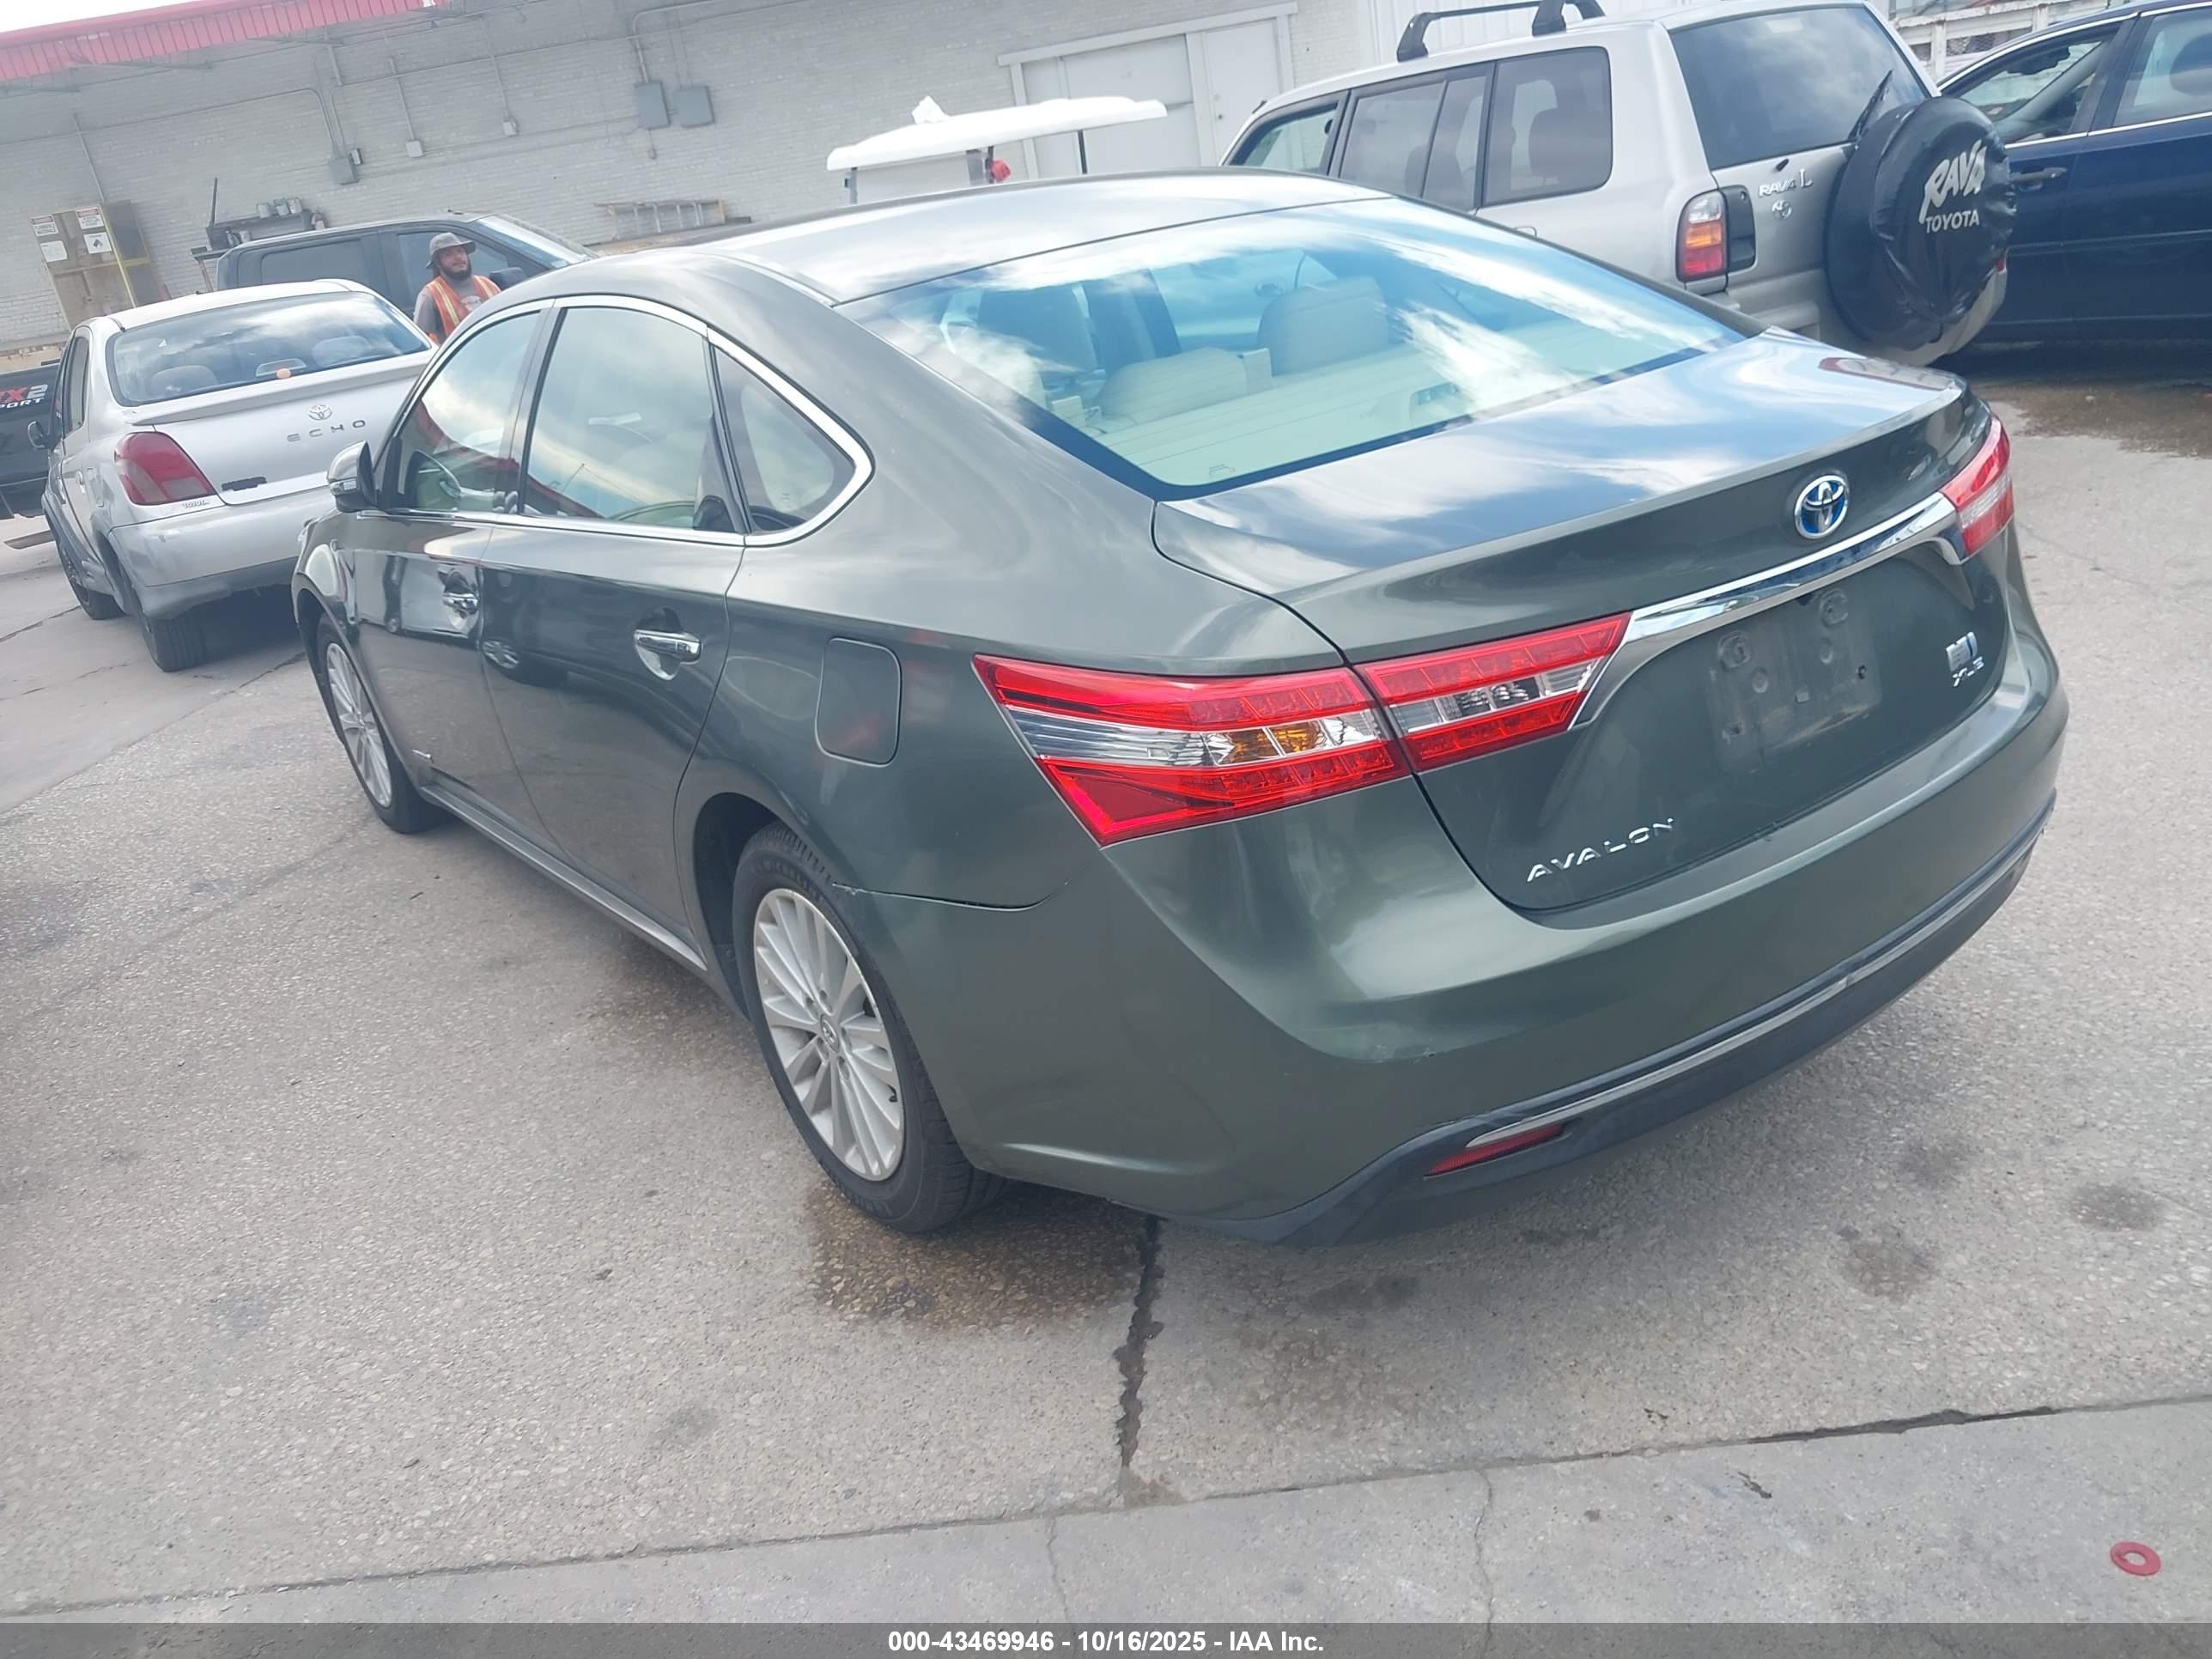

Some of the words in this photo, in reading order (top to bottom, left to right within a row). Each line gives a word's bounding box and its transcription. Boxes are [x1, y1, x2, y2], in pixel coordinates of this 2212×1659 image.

[1918, 139, 1988, 224] RAV4
[1925, 209, 1980, 234] TOYOTA
[287, 420, 366, 442] ECHO
[1526, 817, 1674, 883] AVALON
